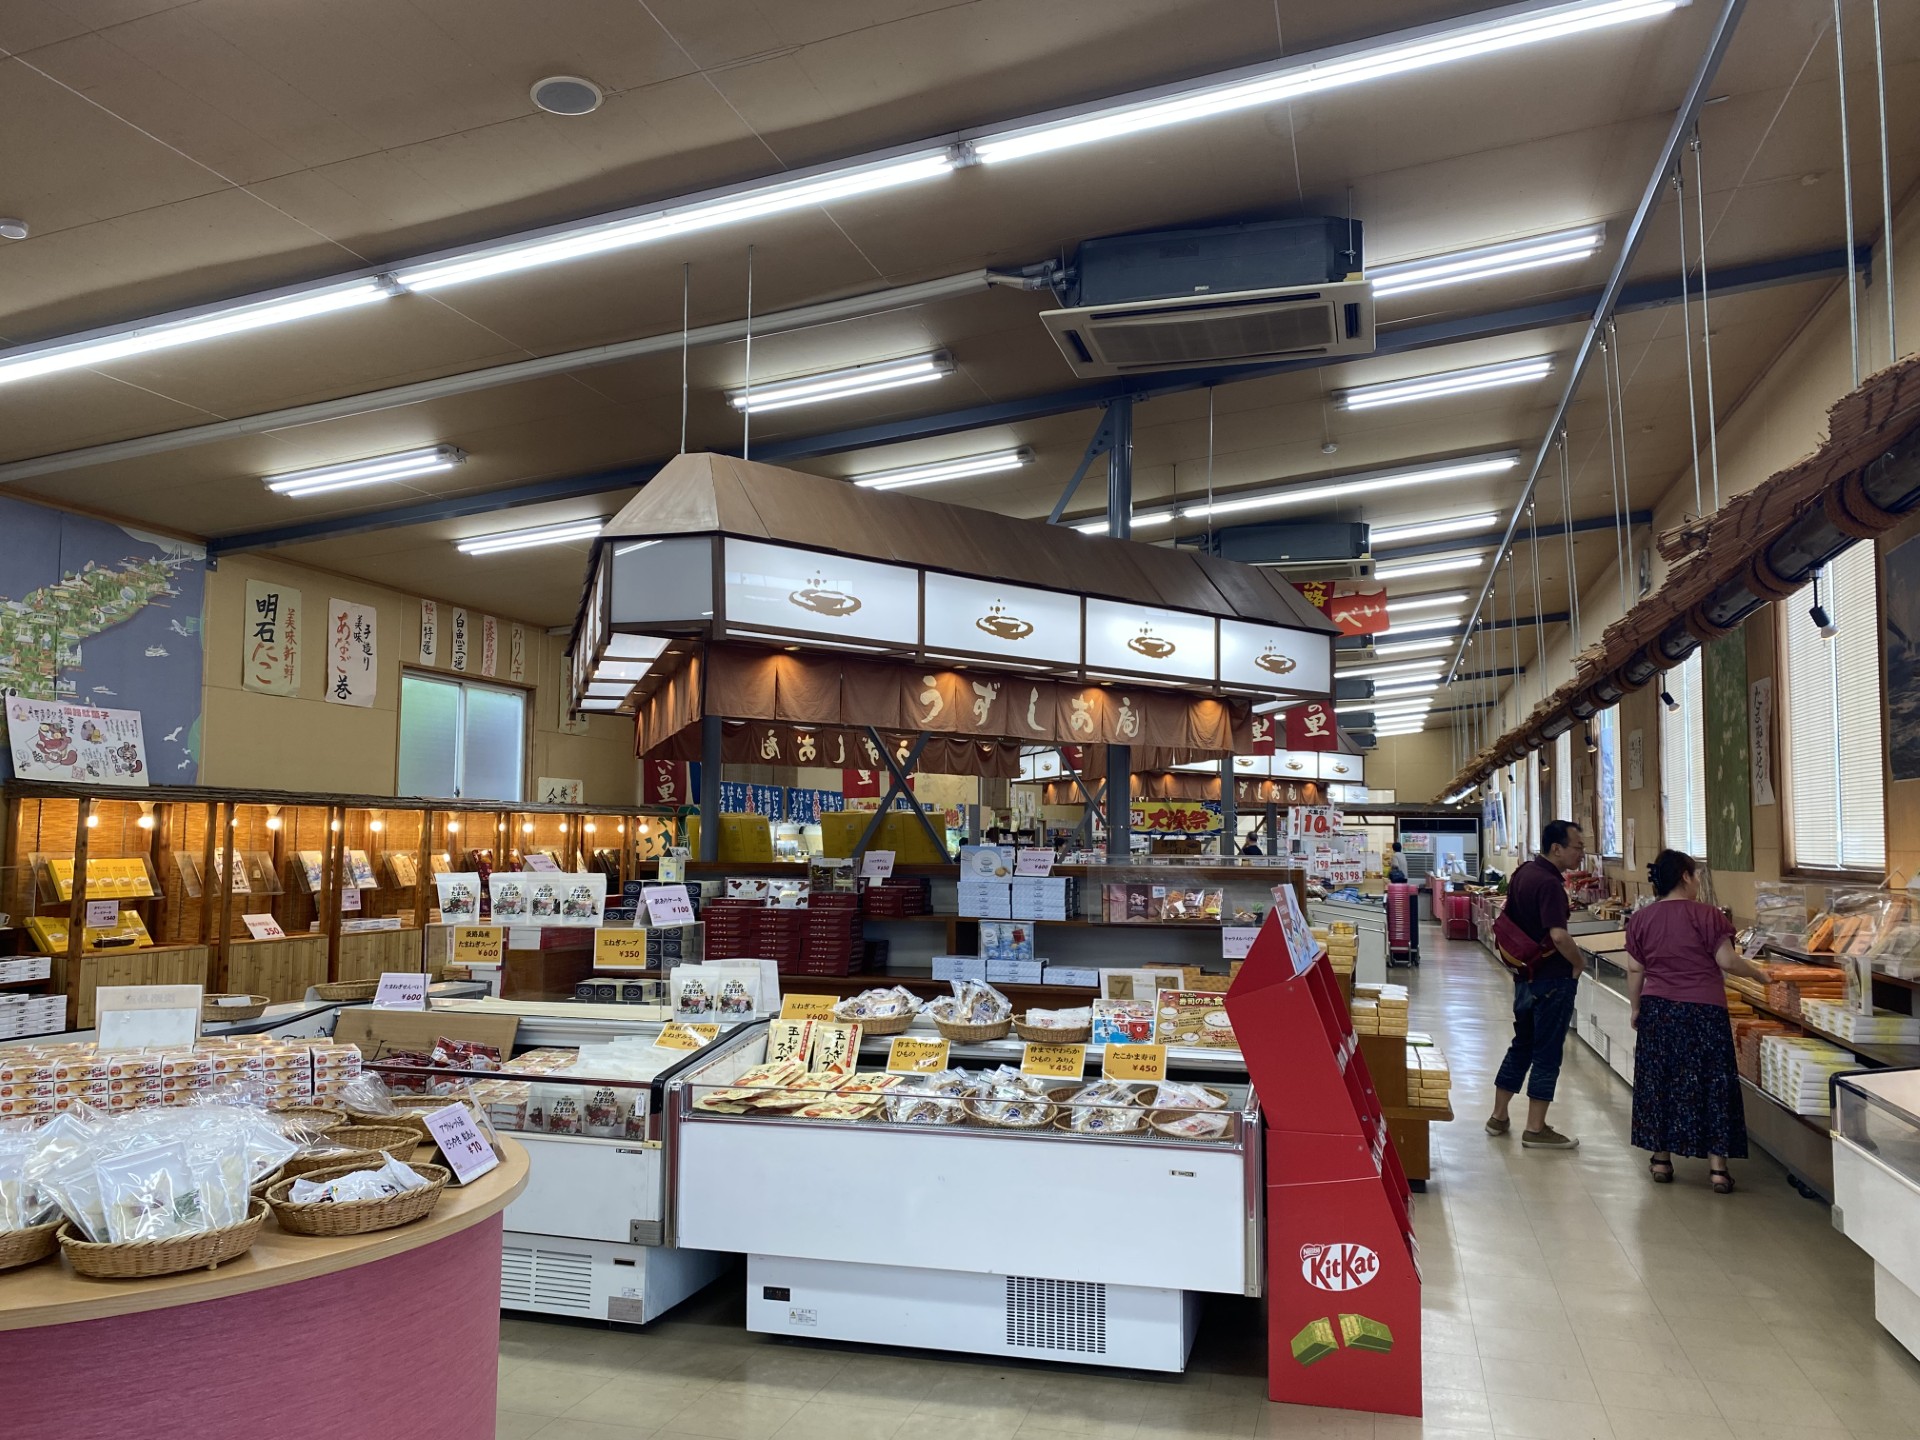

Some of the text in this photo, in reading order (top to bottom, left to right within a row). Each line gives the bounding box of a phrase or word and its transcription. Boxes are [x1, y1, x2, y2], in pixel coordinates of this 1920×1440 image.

[252, 593, 279, 685] 明石たこ
[334, 612, 352, 700] あなご巻
[919, 674, 1140, 739] うずしお庵
[1303, 703, 1330, 737] の里
[1148, 808, 1210, 831] 大漁祭
[603, 939, 639, 947] 玉ねぎスープ
[619, 950, 640, 958] ¥350
[401, 993, 421, 1001] ¥600
[806, 1012, 829, 1020] ¥600
[1049, 1064, 1074, 1072] ¥450
[1132, 1064, 1158, 1073] ¥450
[467, 1141, 483, 1155] ¥70
[1310, 1244, 1377, 1290] KitKat
